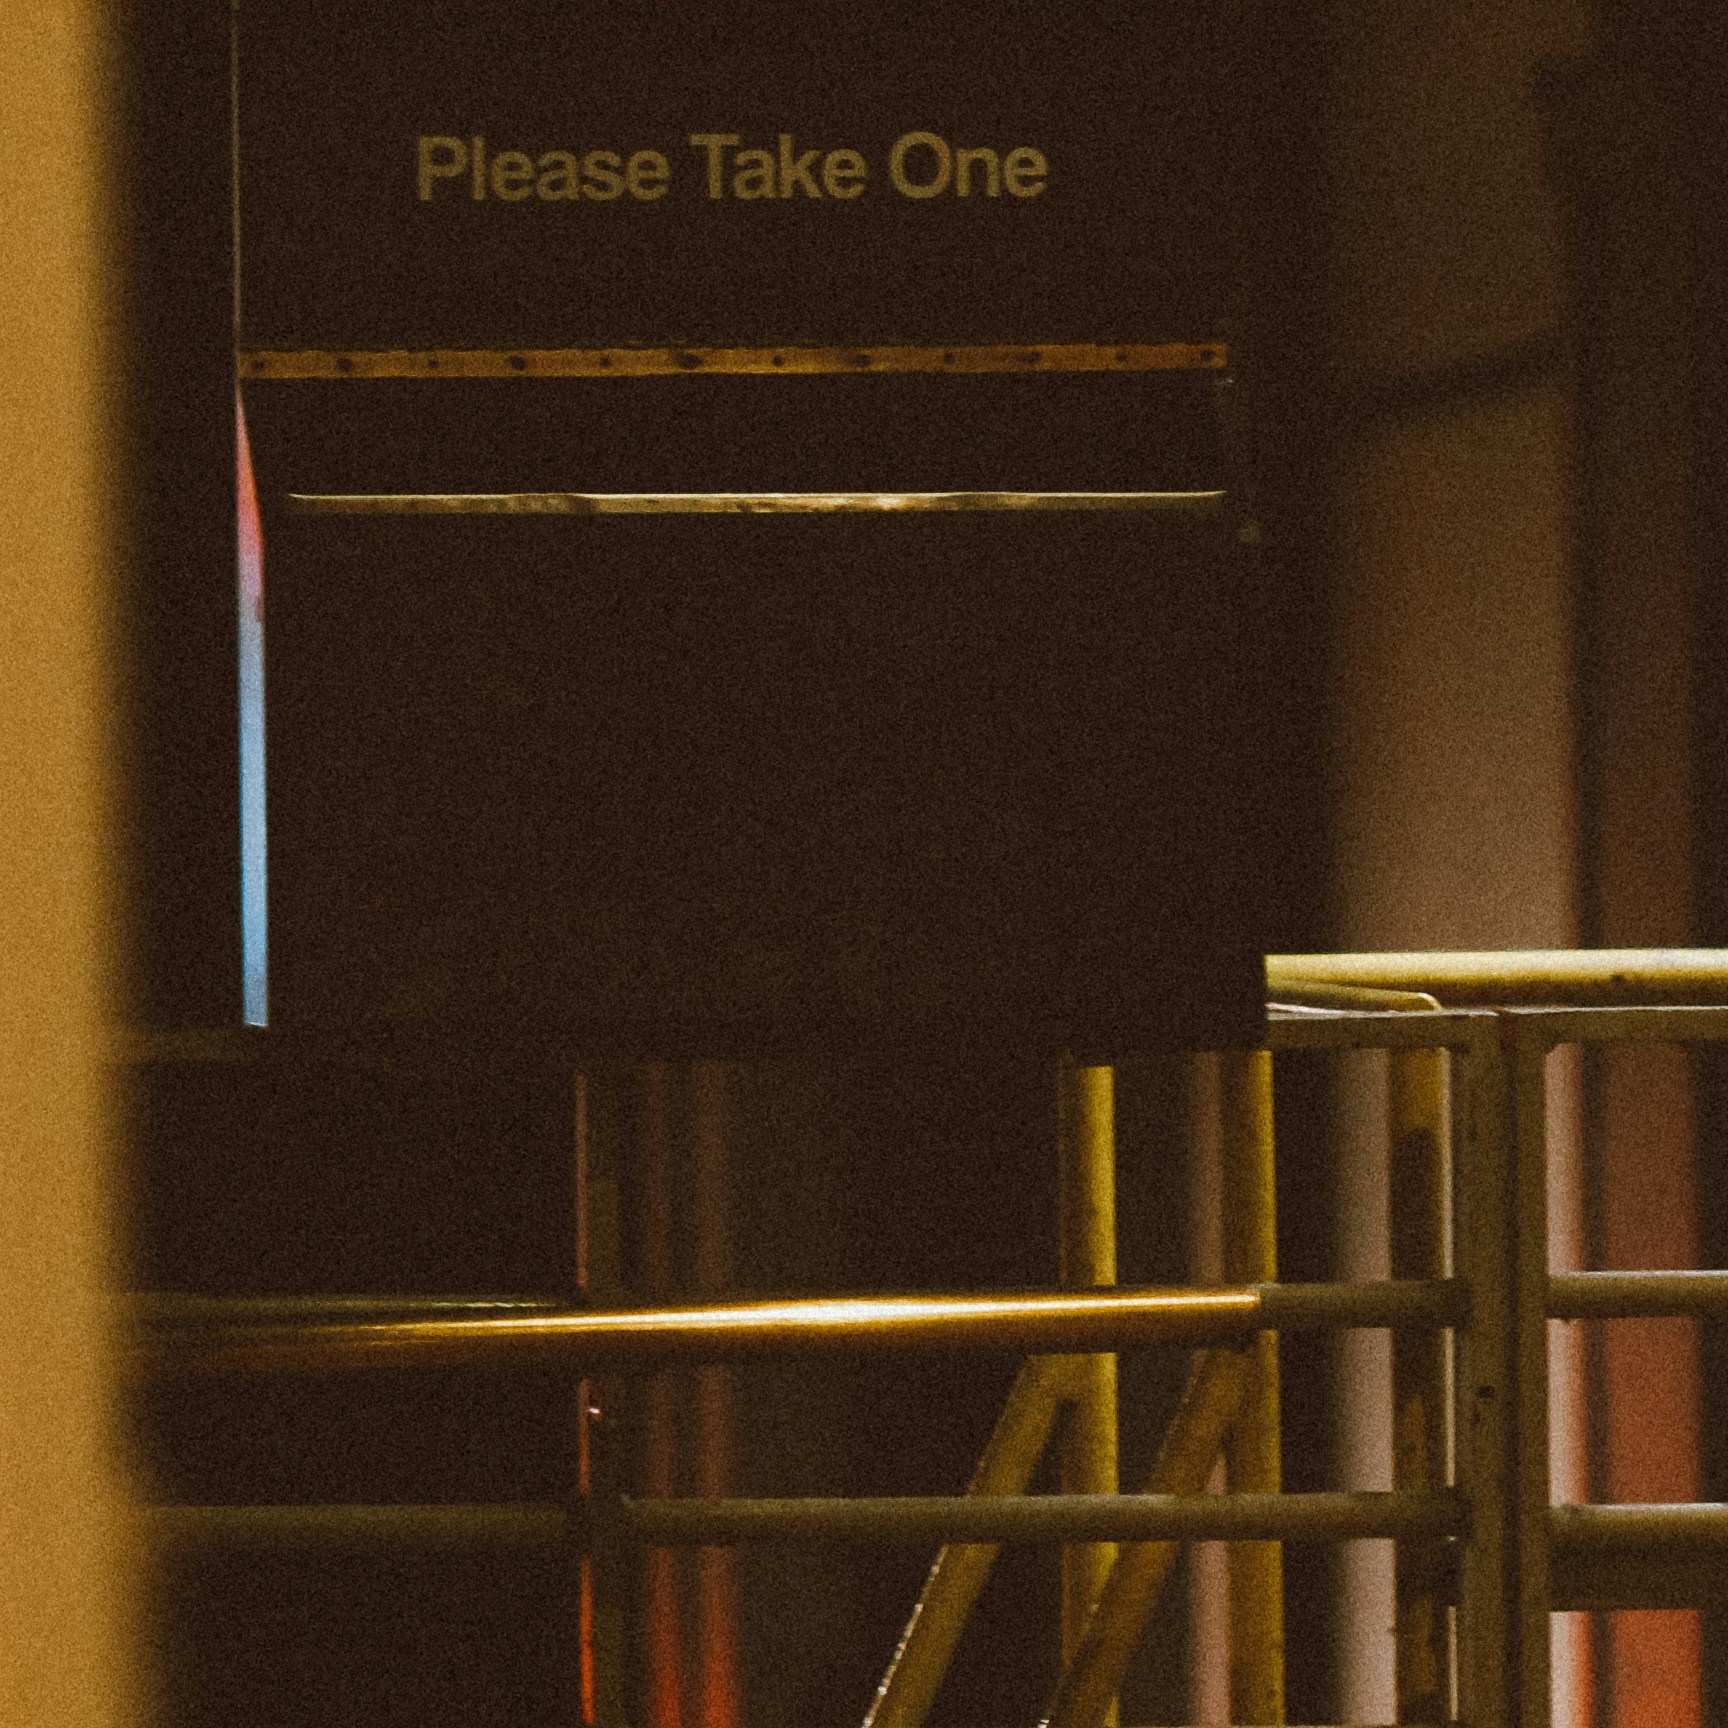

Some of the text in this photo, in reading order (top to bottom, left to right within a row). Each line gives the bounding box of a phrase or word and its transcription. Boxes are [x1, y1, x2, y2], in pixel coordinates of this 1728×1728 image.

[417, 130, 1049, 201] Please Take One
